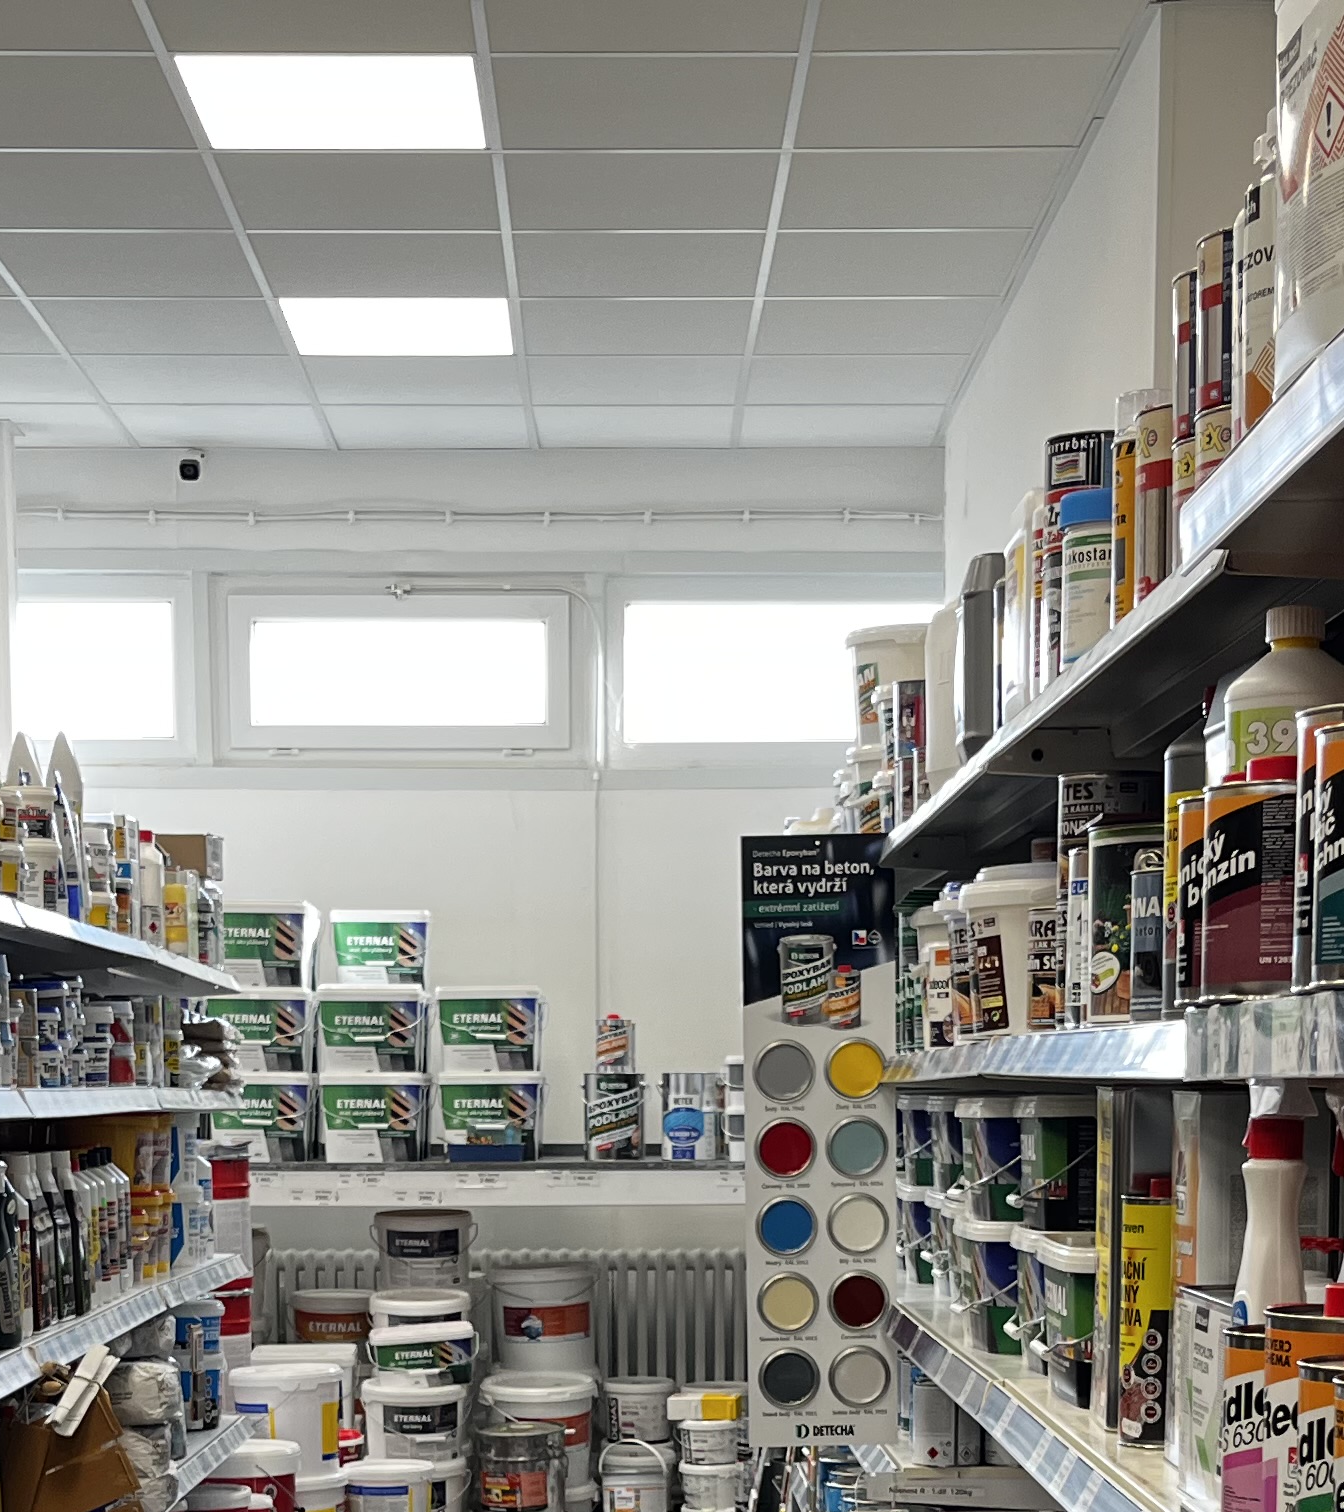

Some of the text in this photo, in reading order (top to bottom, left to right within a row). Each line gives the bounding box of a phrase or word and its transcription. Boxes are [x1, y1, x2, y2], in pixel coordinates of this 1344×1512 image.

[753, 860, 875, 877] Barva na beton,
[753, 877, 848, 897] která vydrží
[758, 901, 840, 913] extrémní zatížení
[347, 936, 394, 946] ETERNAL
[335, 1015, 384, 1026] ETERNAL
[453, 1014, 502, 1024] ETERNAL
[337, 1099, 386, 1109] ETERNAL
[454, 1099, 504, 1109] ETERNAL
[308, 1321, 362, 1333] ETERNAL
[394, 1348, 434, 1360] ETERNAL
[393, 1413, 432, 1423] ETERNAL
[813, 1425, 854, 1437] DETECHA
